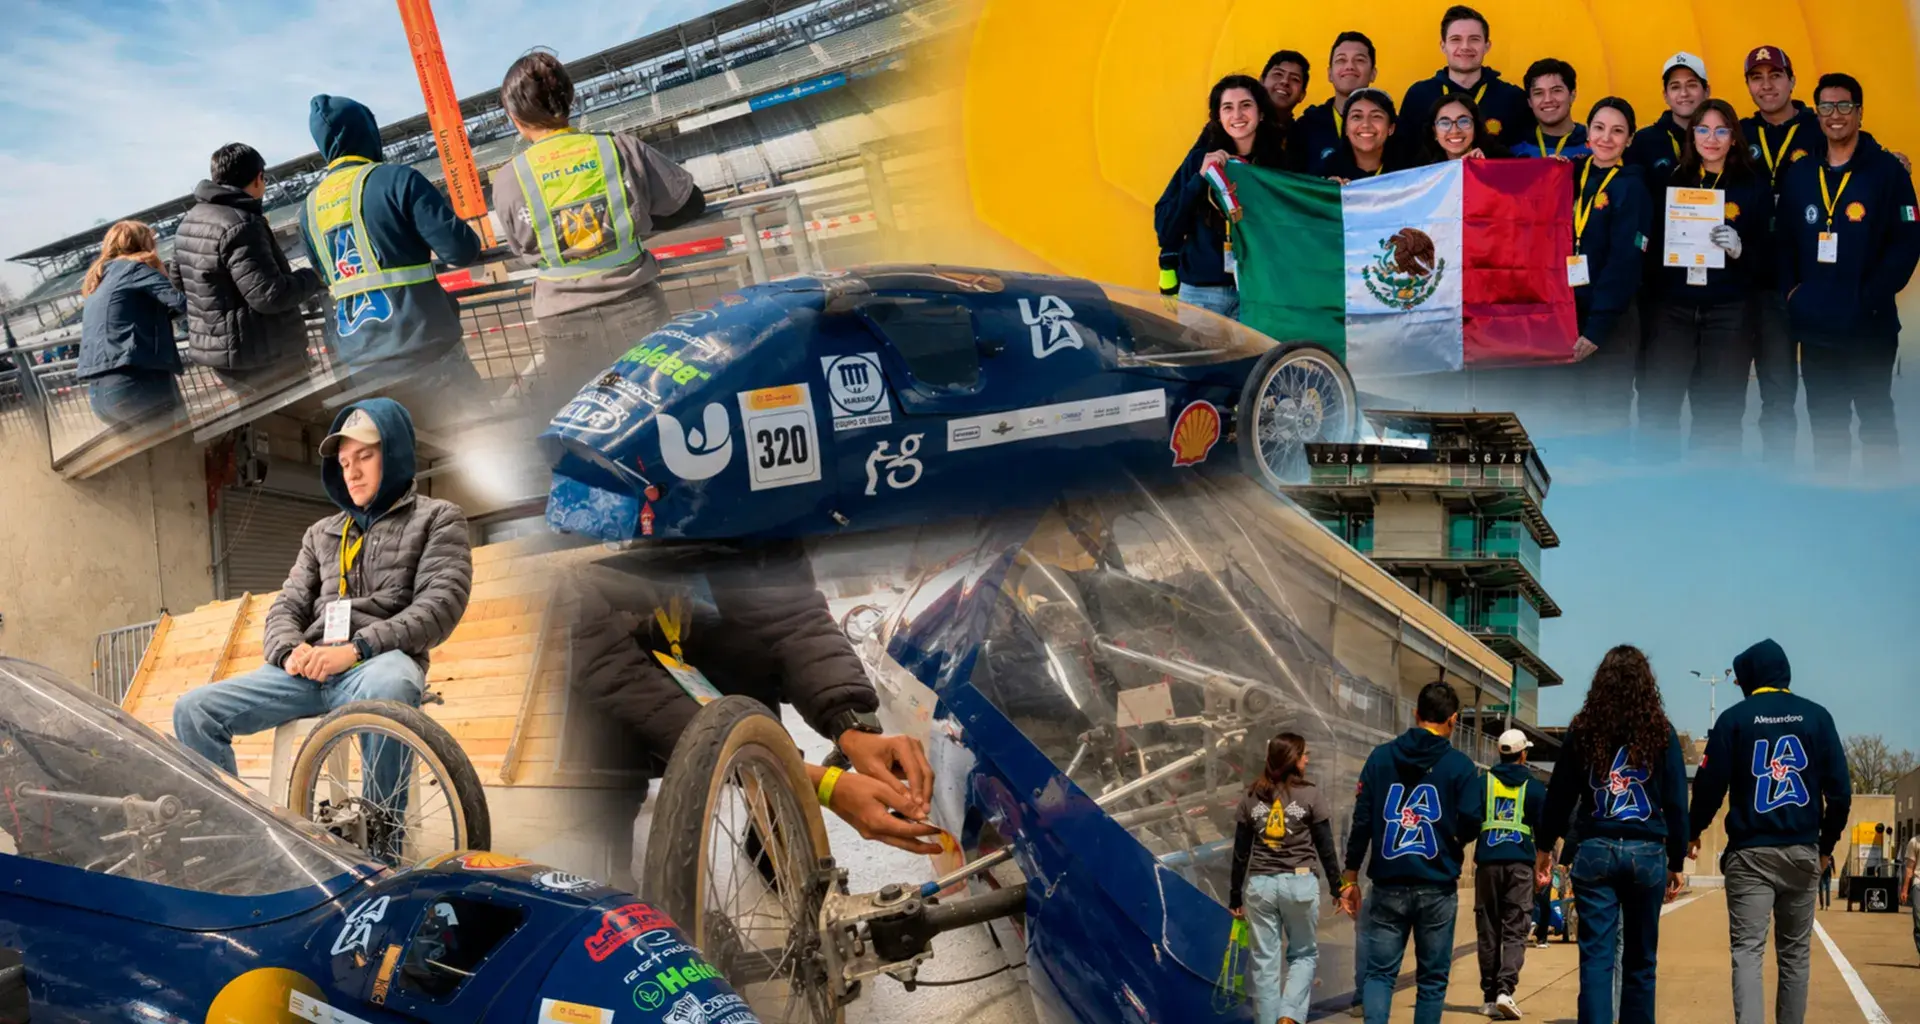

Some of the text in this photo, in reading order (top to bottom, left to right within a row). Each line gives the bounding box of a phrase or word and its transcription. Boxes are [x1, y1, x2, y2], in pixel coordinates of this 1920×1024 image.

[542, 159, 597, 181] PIT LANE
[757, 424, 808, 469] 320
[1312, 453, 1364, 464] 1 2 3 4
[1468, 453, 1523, 464] 5 6 7 8
